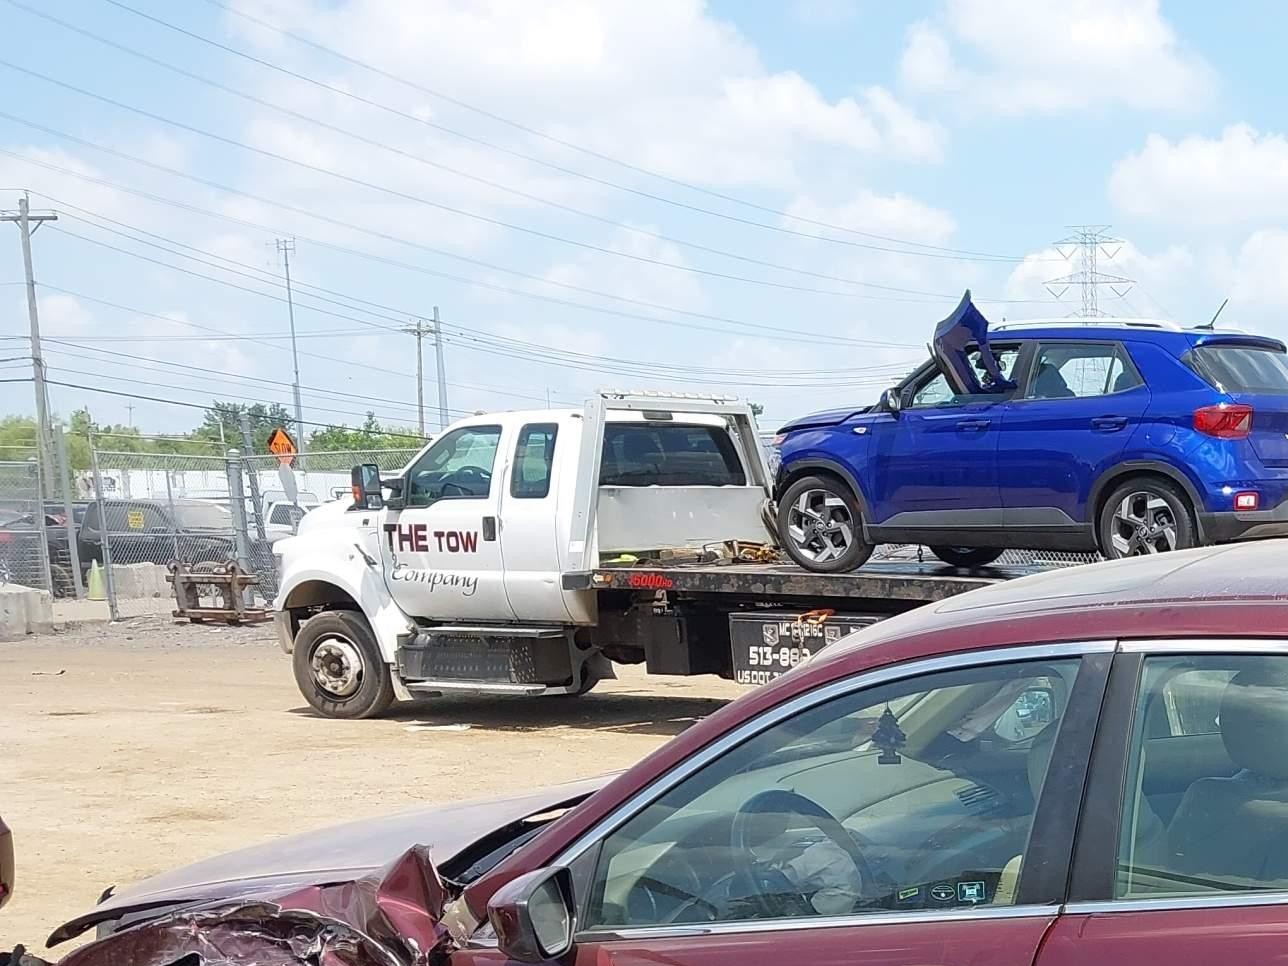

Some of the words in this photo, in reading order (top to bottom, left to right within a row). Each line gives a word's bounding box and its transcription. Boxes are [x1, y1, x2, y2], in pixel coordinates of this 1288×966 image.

[383, 524, 429, 552] THE
[434, 531, 478, 552] TOW
[392, 563, 479, 596] Company
[779, 623, 790, 636] MC
